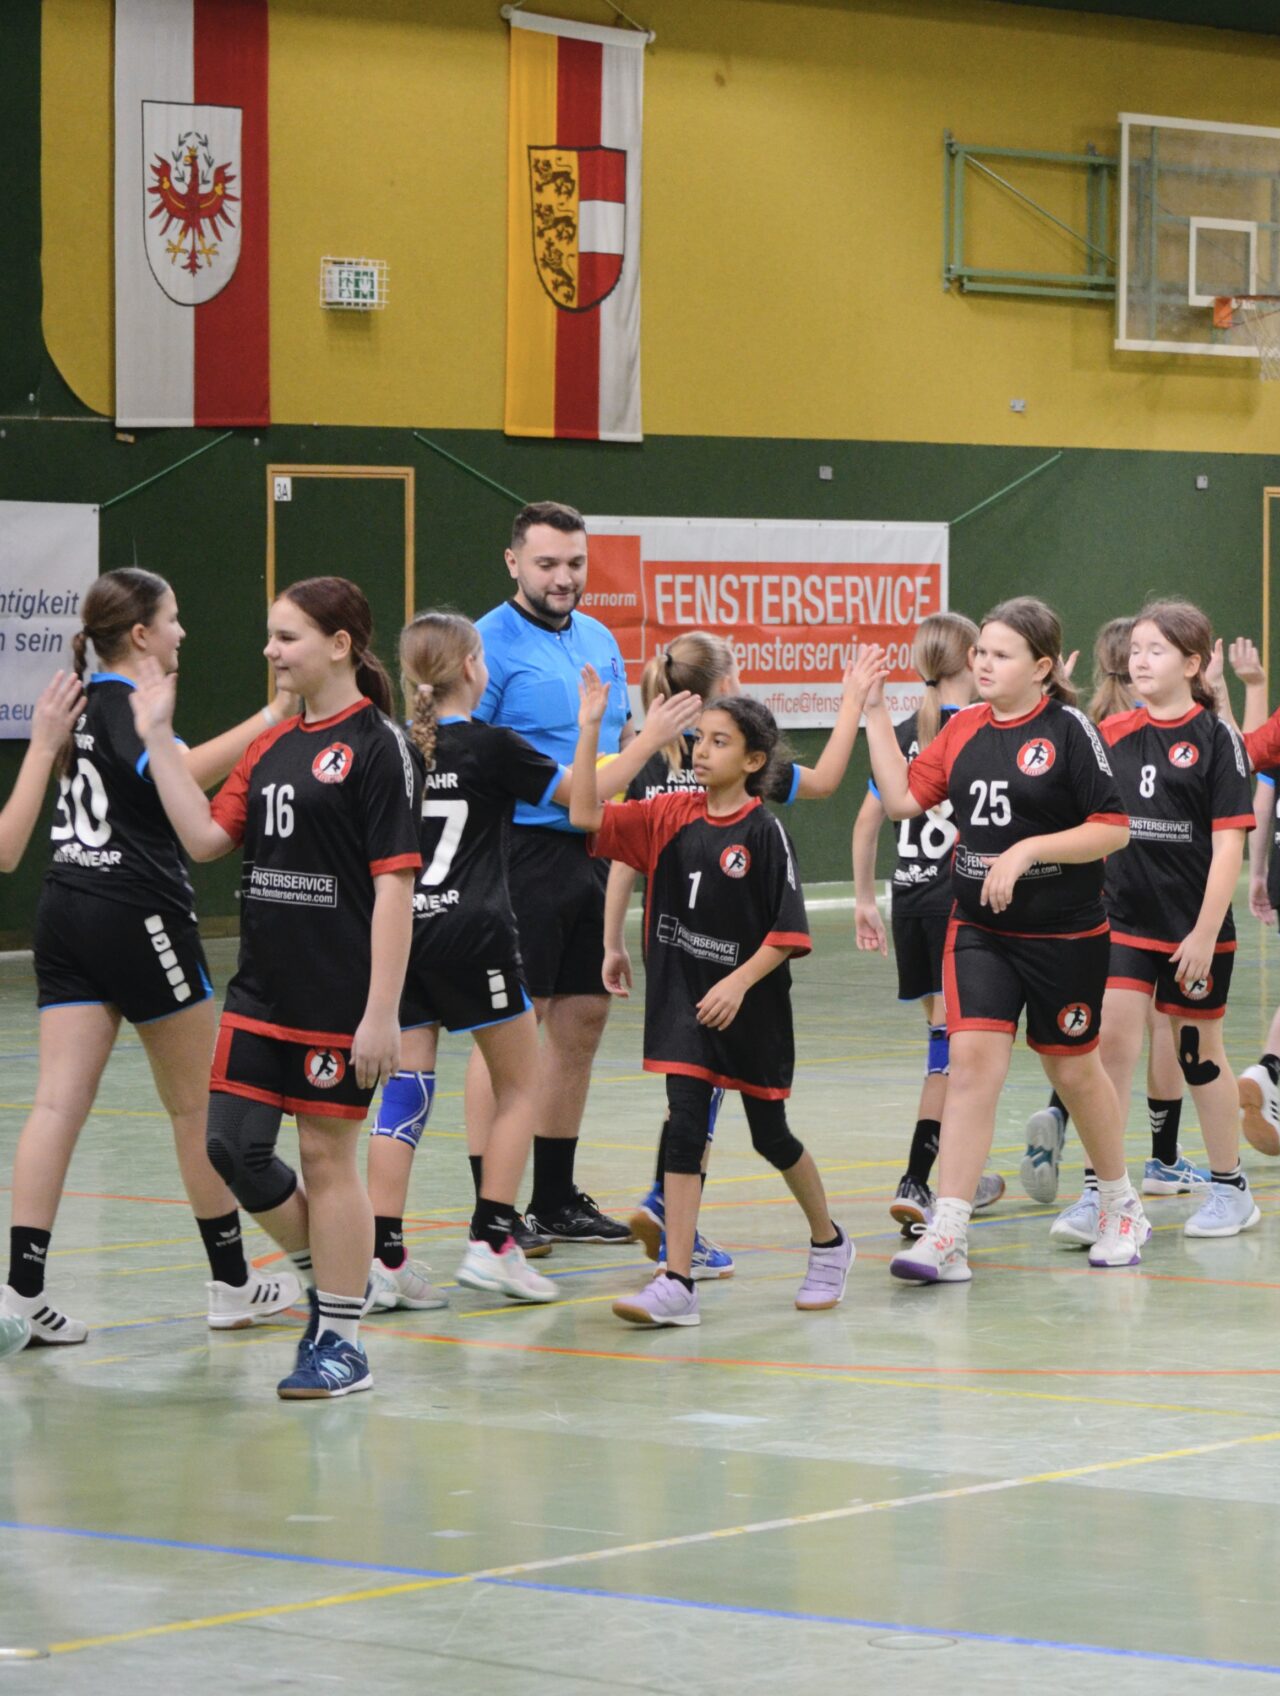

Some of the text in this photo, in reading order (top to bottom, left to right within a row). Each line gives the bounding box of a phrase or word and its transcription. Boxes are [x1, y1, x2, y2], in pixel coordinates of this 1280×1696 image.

[579, 592, 637, 607] ernorm
[655, 574, 931, 625] FENSTERSERVICE
[15, 627, 63, 652] sein
[666, 769, 697, 784] ASK
[1139, 765, 1156, 798] 8
[261, 783, 295, 838] 16
[969, 780, 1012, 827] 25
[421, 799, 469, 886] 7
[688, 871, 702, 909] 1
